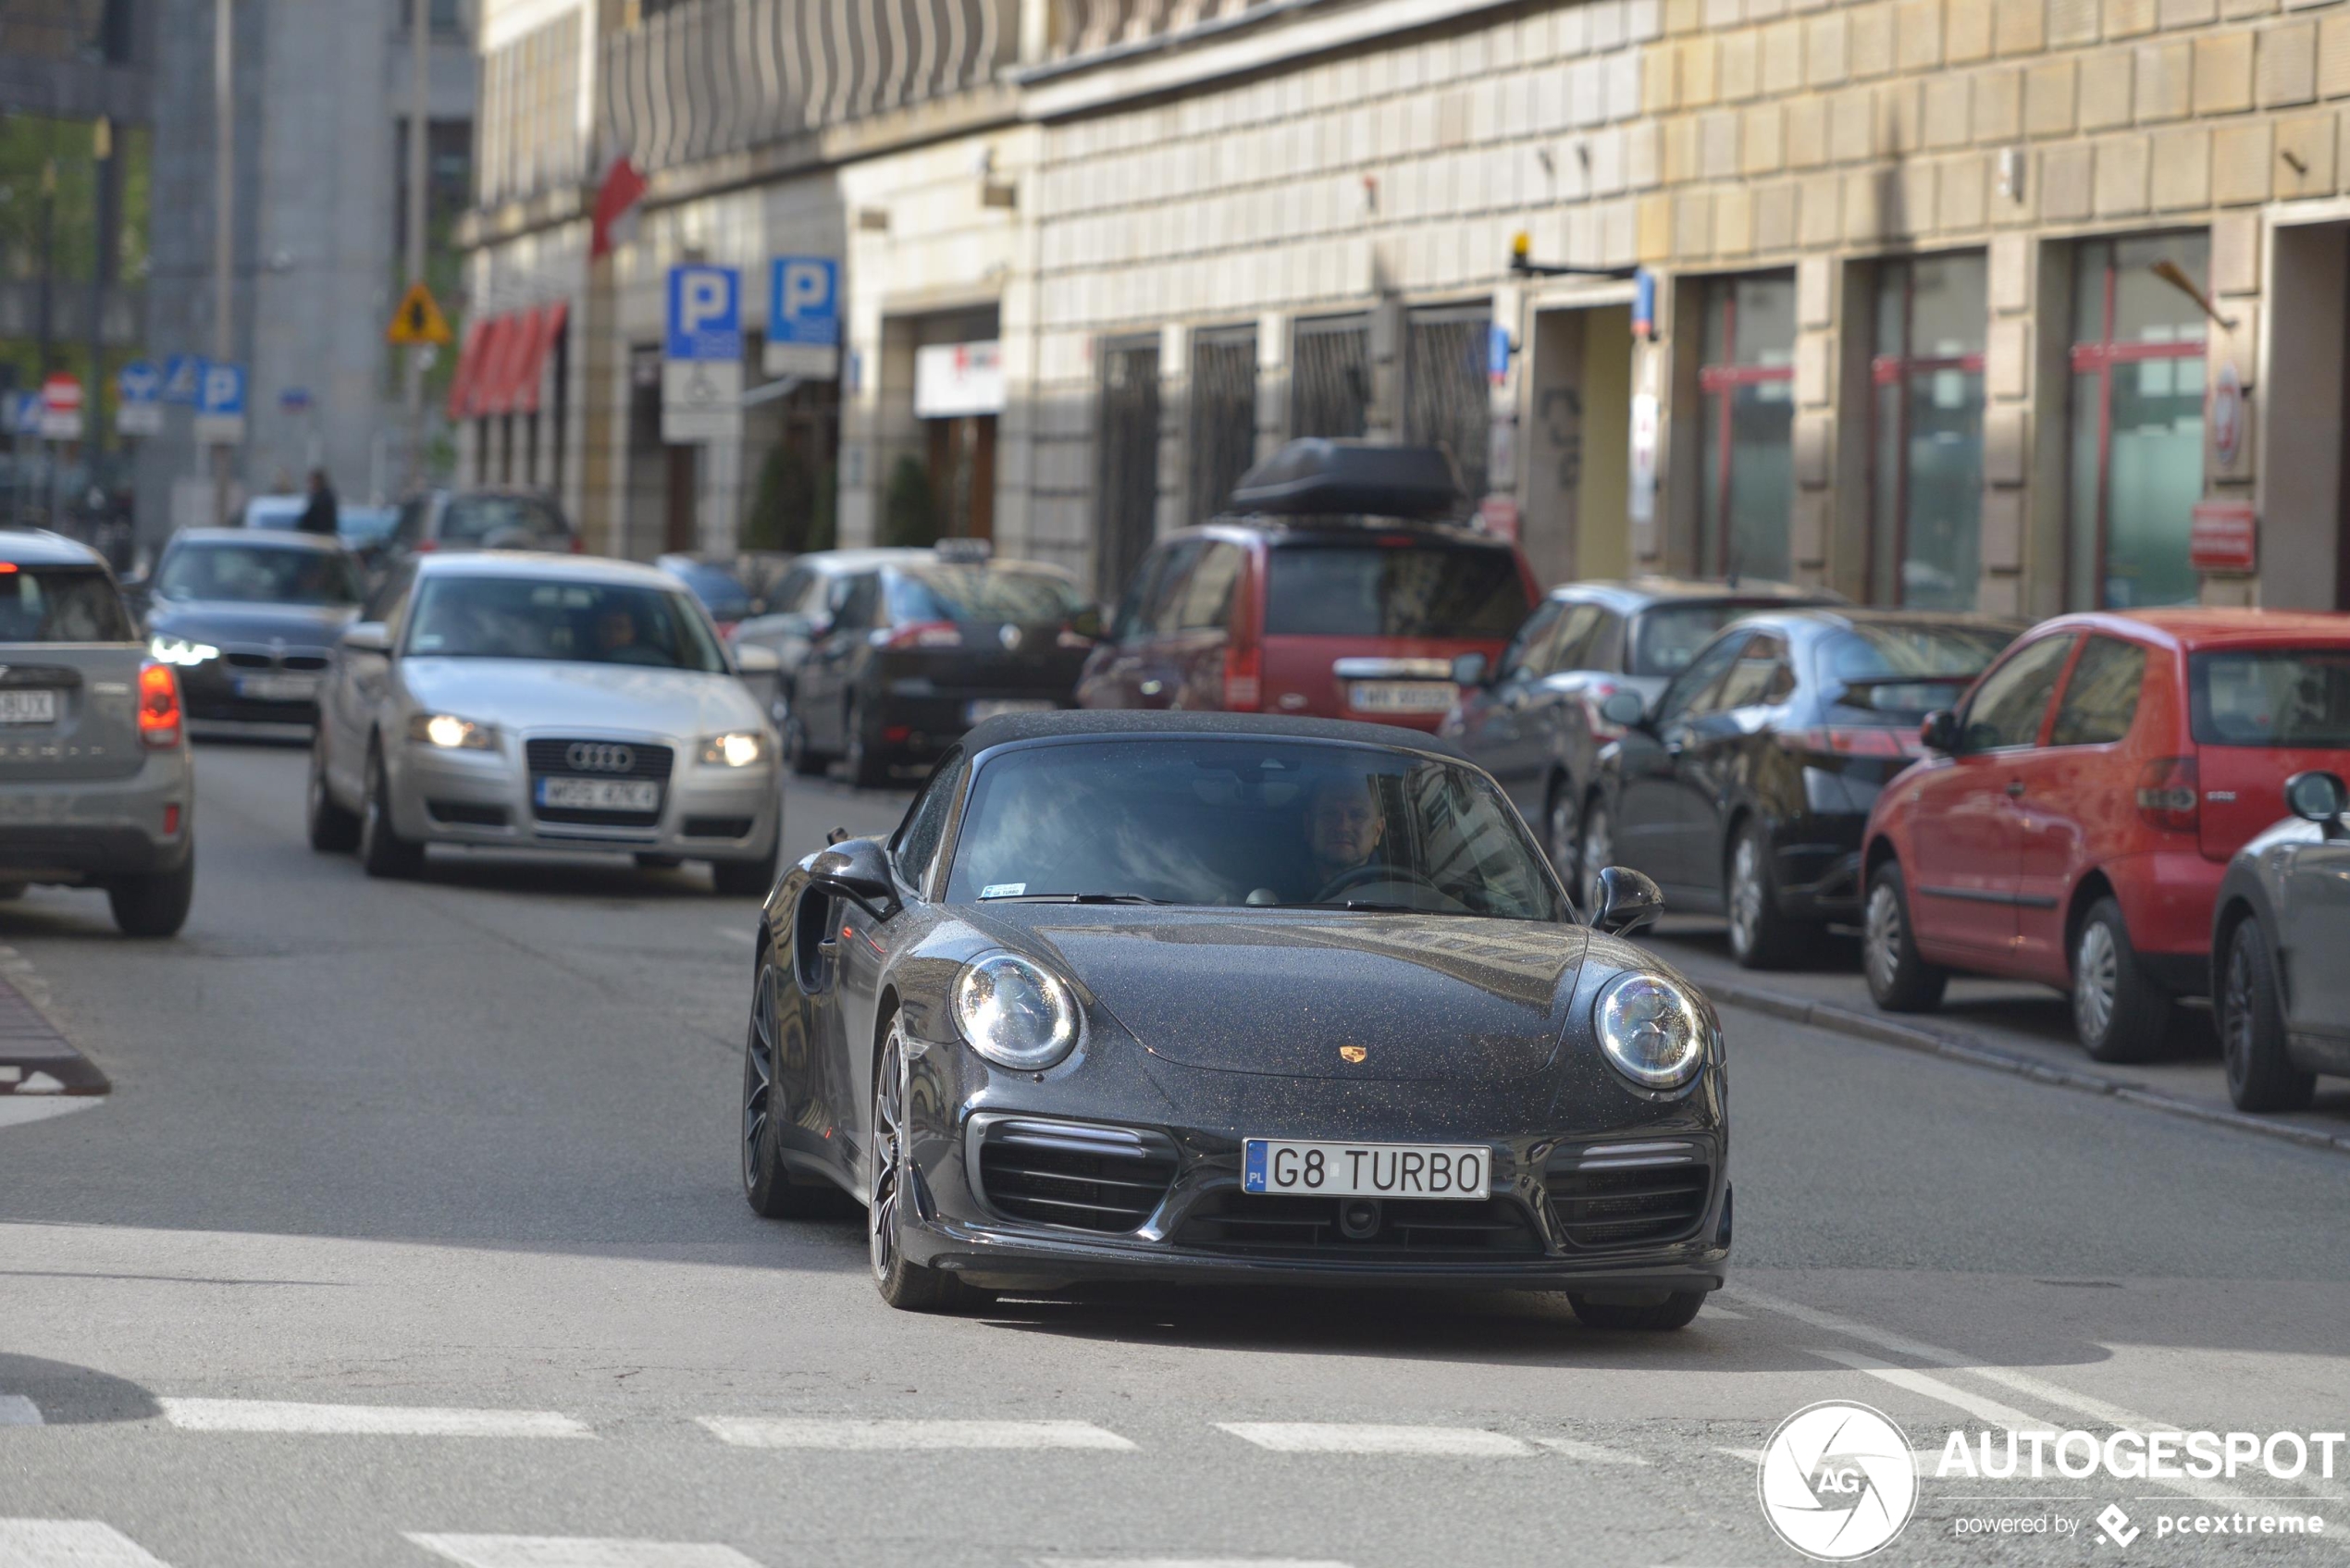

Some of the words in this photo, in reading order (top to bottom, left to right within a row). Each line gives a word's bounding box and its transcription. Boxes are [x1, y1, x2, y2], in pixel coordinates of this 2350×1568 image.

[681, 273, 728, 334] P
[784, 263, 828, 320] P
[204, 369, 240, 411] P
[1249, 1172, 1264, 1184] PL
[1274, 1148, 1325, 1188] G8
[1345, 1150, 1480, 1192] TURBO
